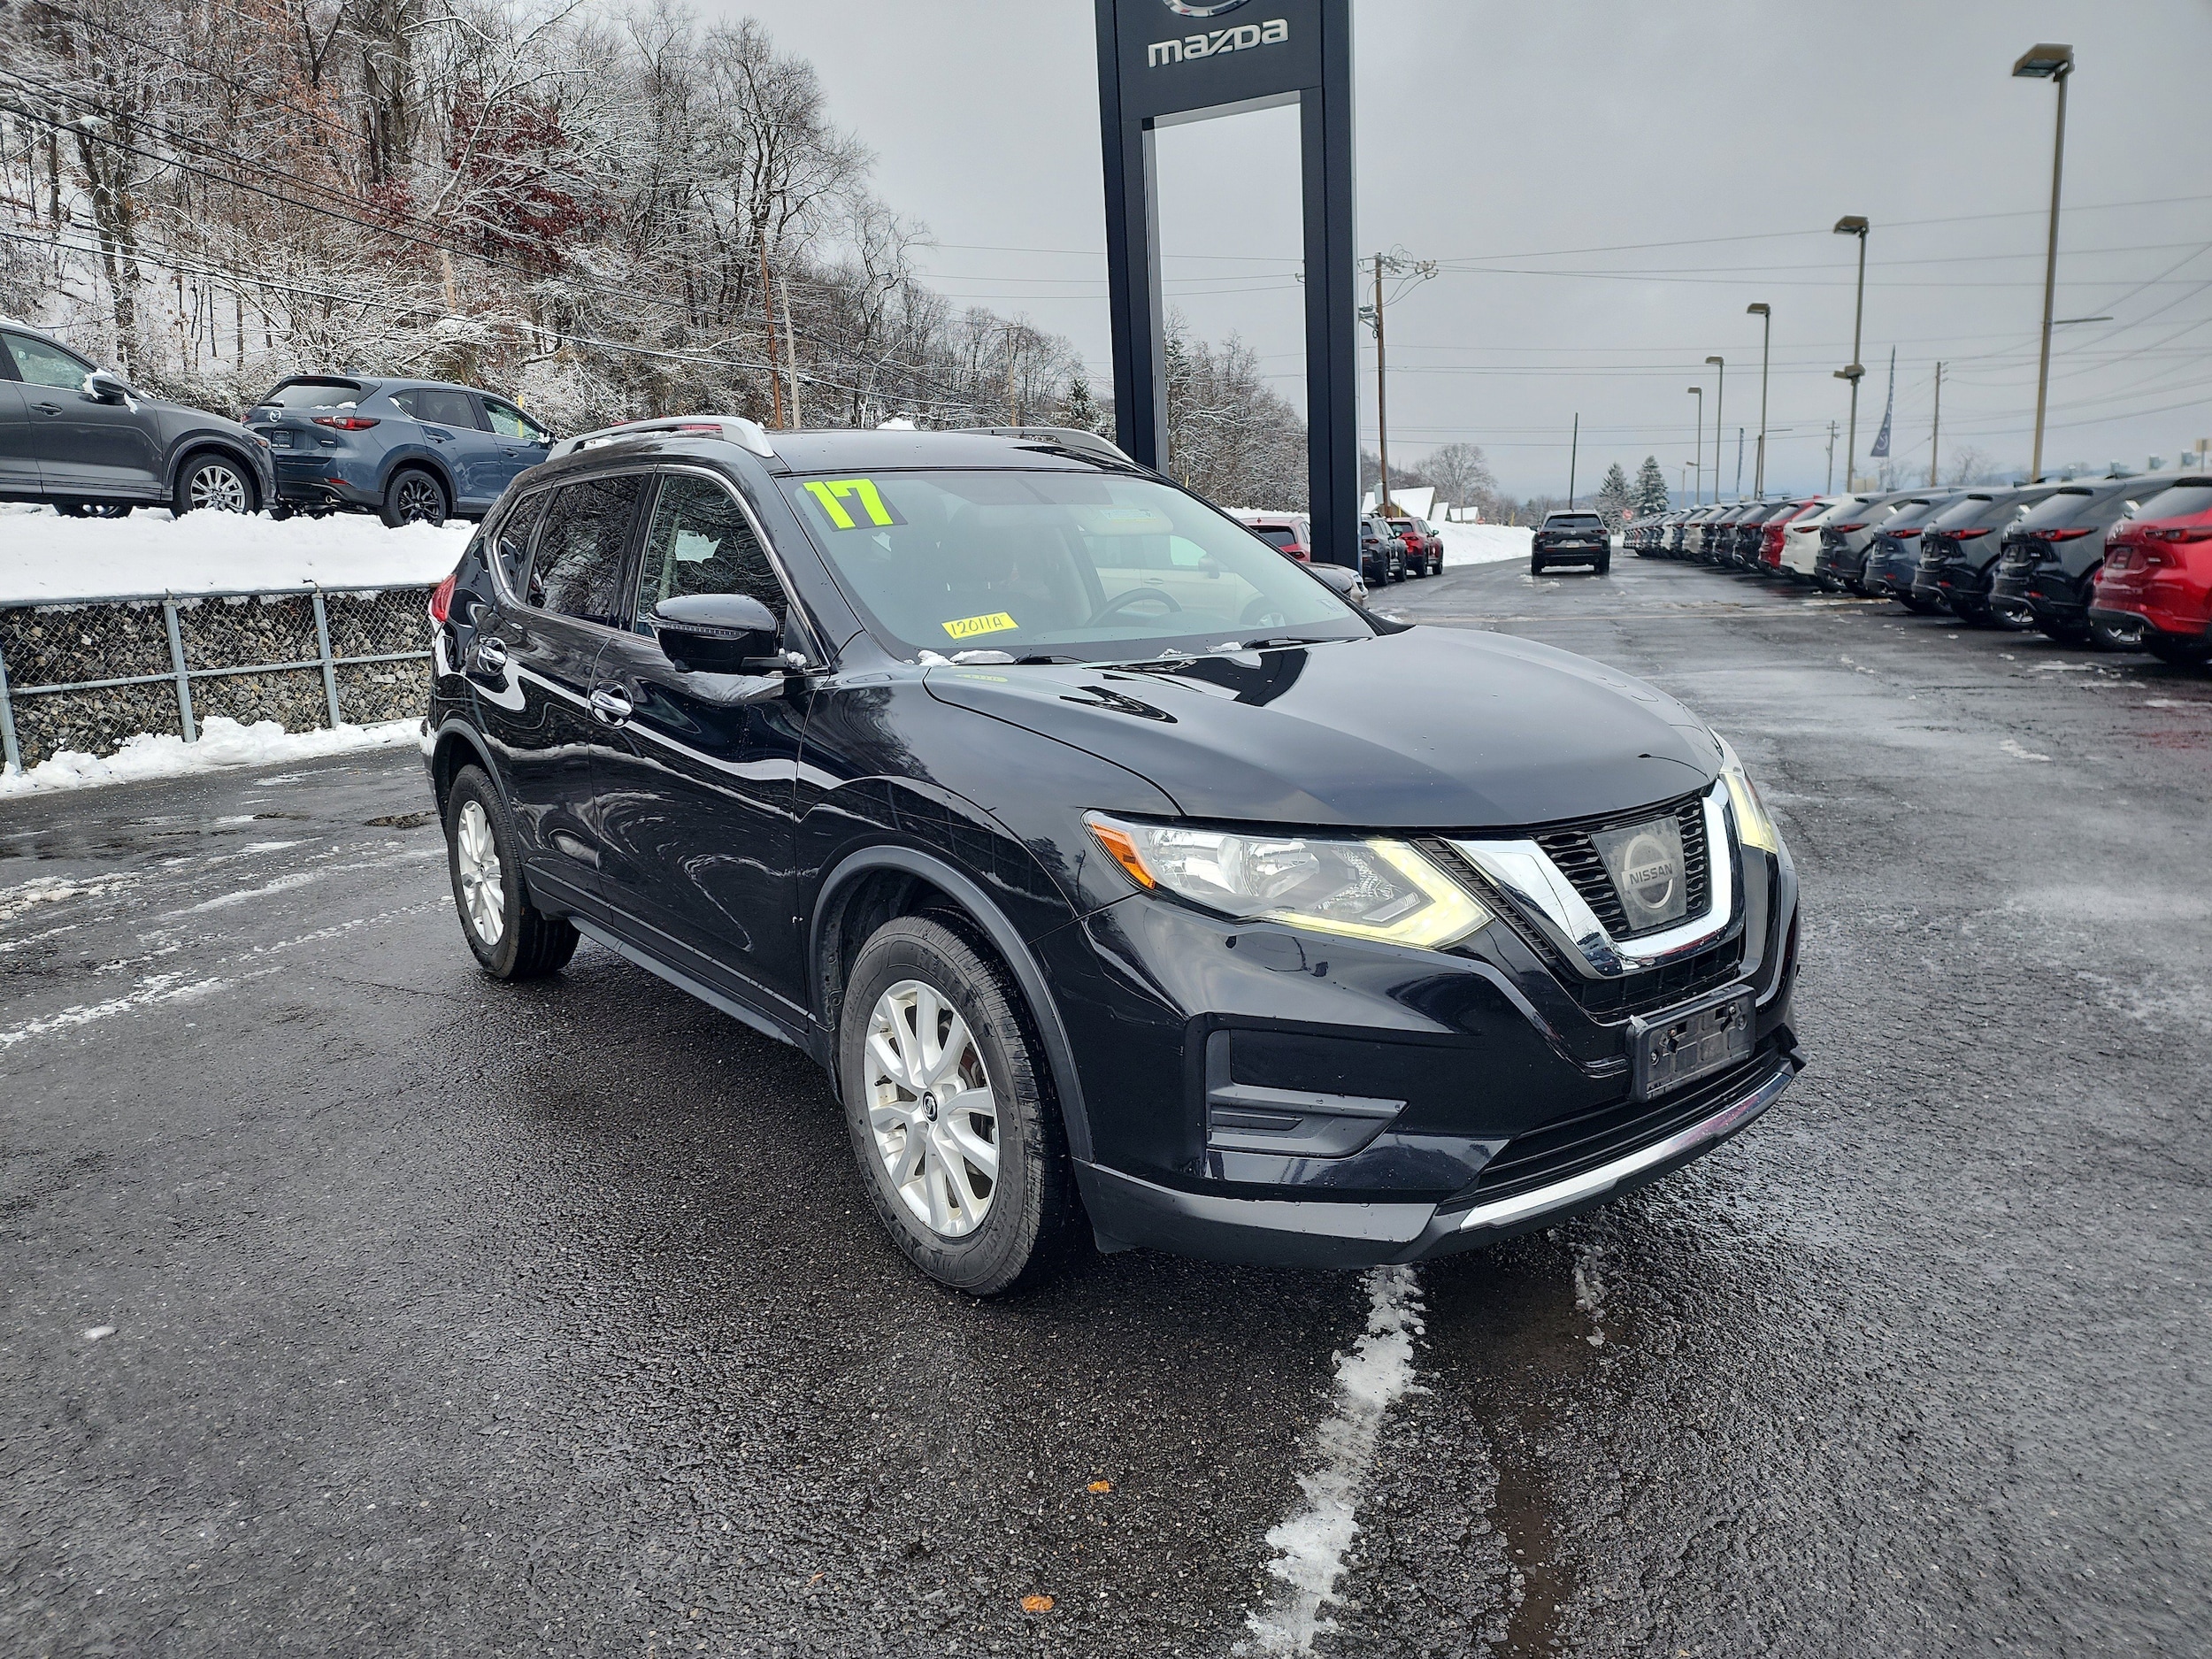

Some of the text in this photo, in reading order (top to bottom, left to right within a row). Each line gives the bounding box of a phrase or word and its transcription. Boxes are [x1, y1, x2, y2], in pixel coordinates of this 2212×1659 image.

[1148, 18, 1289, 67] mazda
[803, 478, 894, 529] 17
[950, 616, 1004, 635] 12011A
[1629, 863, 1673, 885] NISSAN
